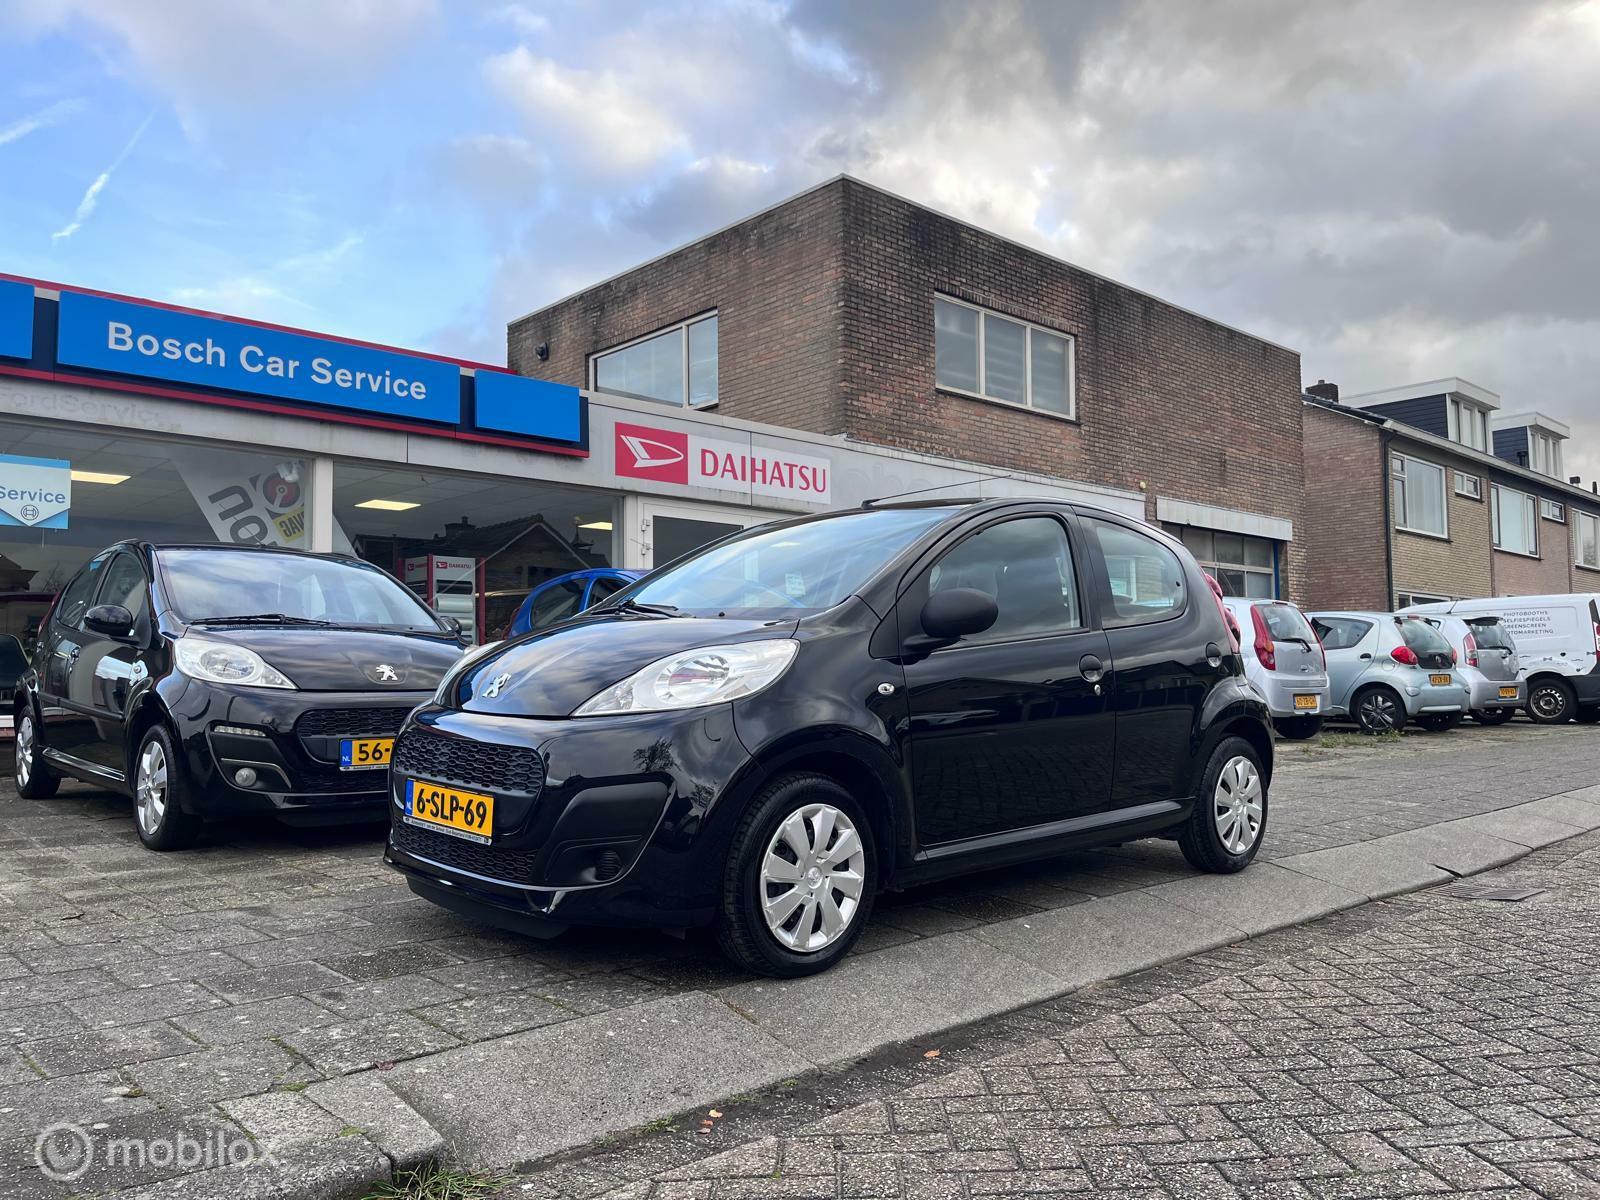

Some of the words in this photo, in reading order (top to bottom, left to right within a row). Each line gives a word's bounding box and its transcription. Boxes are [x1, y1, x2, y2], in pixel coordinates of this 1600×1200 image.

[108, 321, 226, 367] Bosch
[239, 345, 300, 379] Car
[310, 358, 427, 400] Service
[700, 448, 827, 494] DAIHATSU
[0, 486, 66, 504] Service
[1503, 616, 1551, 624] SELFIESPIEGELS
[358, 742, 394, 761] 56-
[416, 788, 487, 829] 6-SLP-69
